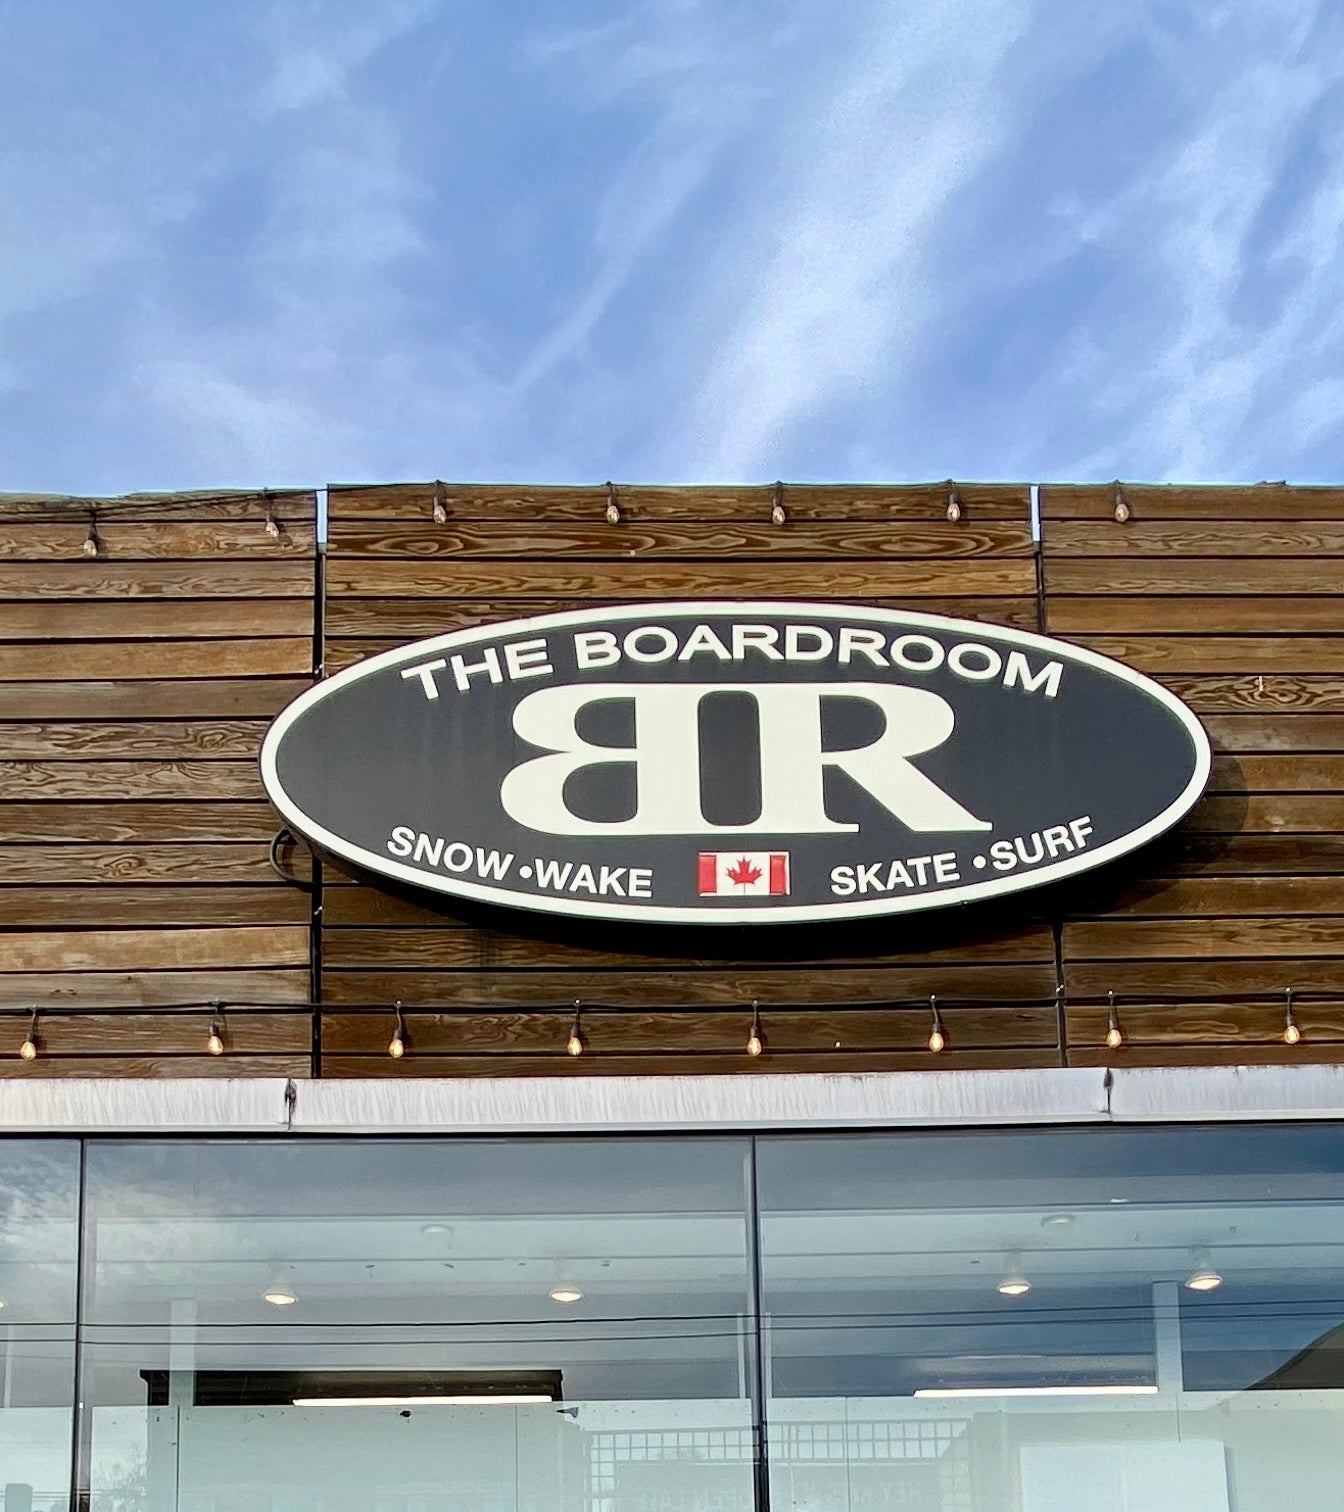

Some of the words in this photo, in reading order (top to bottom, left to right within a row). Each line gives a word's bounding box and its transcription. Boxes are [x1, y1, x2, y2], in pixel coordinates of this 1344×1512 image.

[400, 638, 554, 700] THE
[573, 624, 1064, 698] BOARDROOM
[386, 825, 514, 881] SNOW
[534, 858, 653, 898] WAKE
[830, 852, 960, 895] SKATE
[990, 816, 1093, 871] SURF
